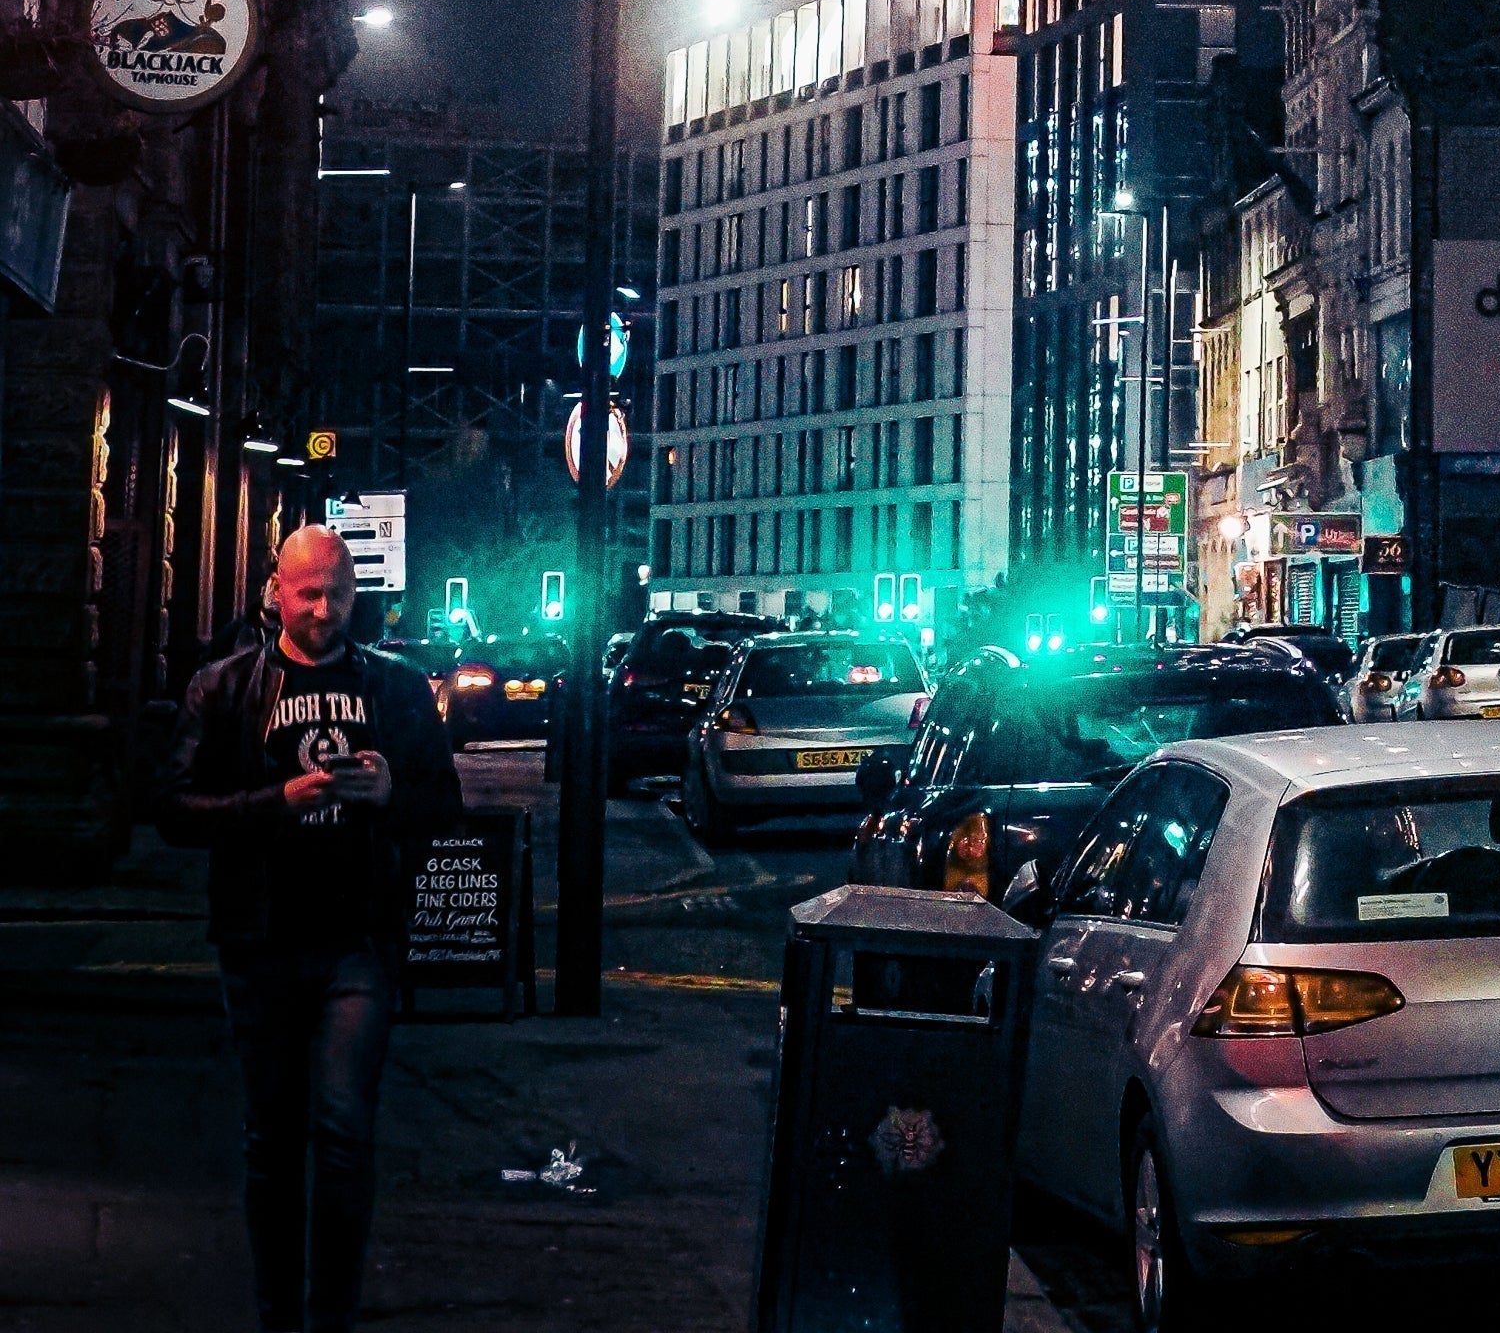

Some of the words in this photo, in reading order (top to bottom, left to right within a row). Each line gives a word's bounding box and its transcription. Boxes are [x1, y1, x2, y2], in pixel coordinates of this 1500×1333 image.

[107, 50, 224, 75] BLACKJACK
[131, 71, 199, 86] TAPHOUSE
[1301, 524, 1315, 544] P
[426, 858, 439, 873] 6
[440, 857, 482, 872] CASK
[415, 874, 428, 890] 12
[430, 874, 456, 890] KEG
[458, 873, 499, 890] LINES
[416, 892, 447, 909] FINE
[449, 891, 498, 908] CIDERS
